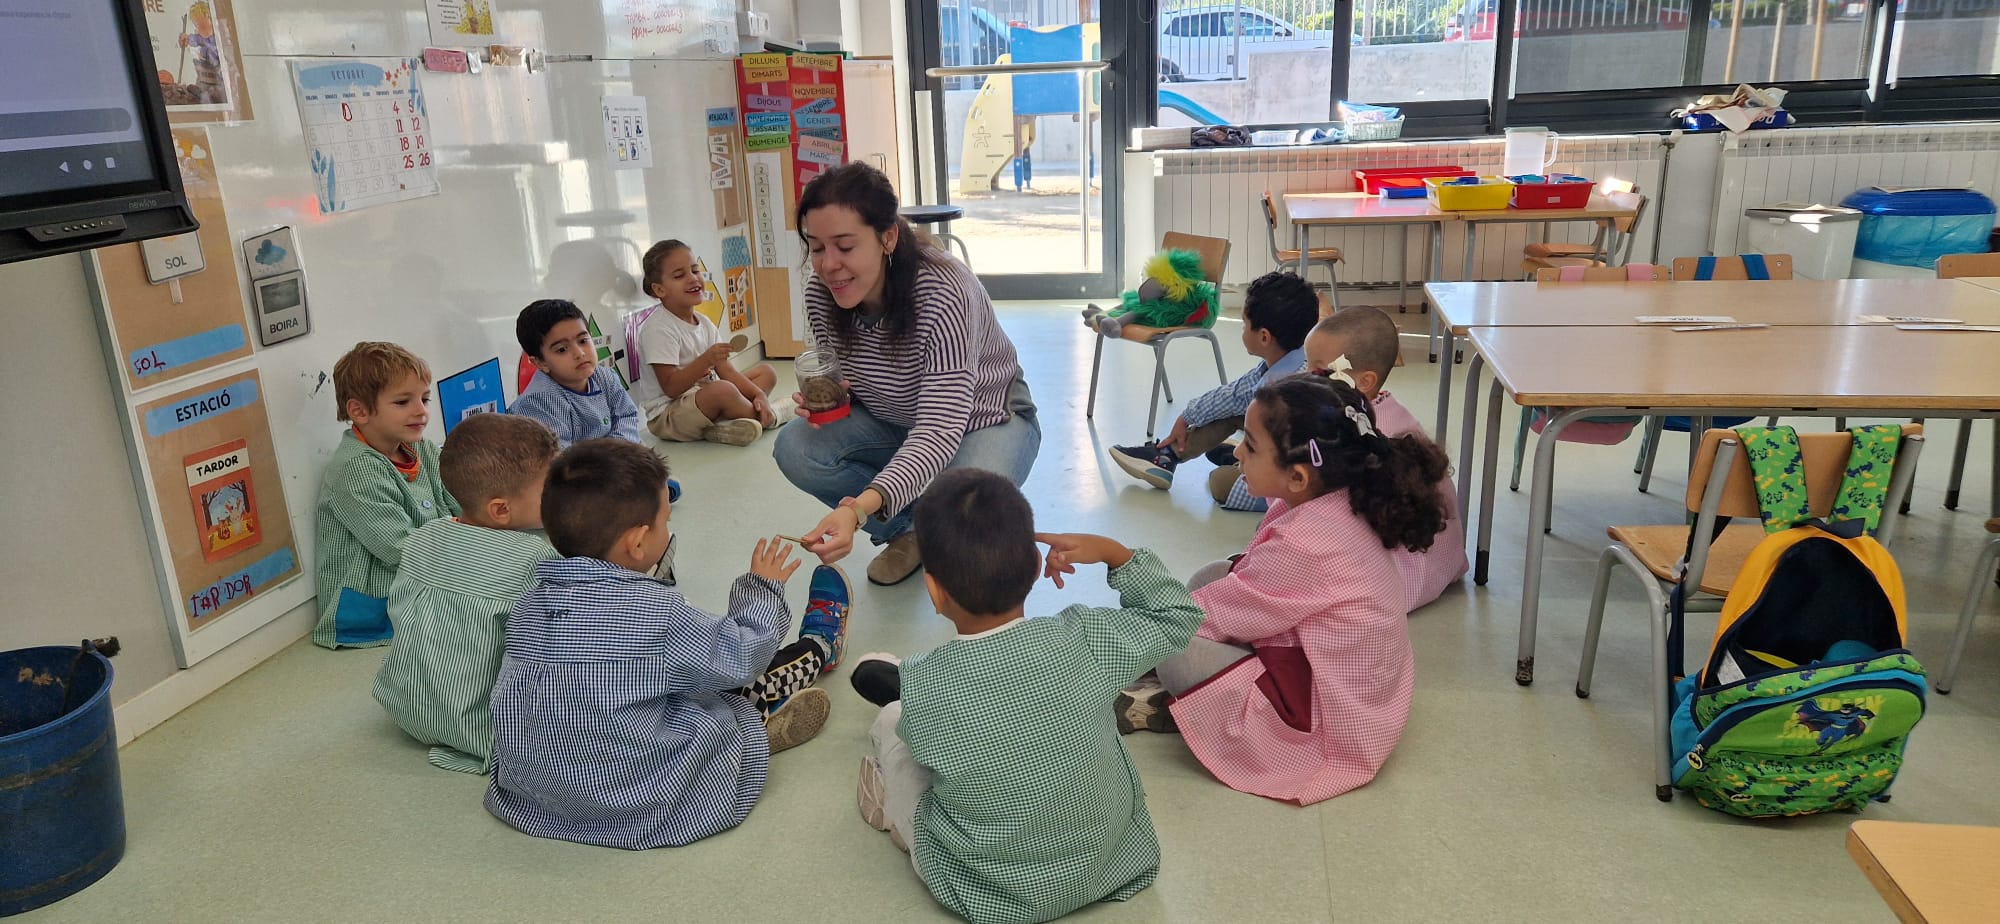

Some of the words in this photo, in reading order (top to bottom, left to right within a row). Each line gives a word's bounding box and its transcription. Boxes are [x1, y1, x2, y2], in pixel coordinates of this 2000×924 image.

[749, 57, 780, 65] DILLUNS
[796, 56, 833, 67] SETEMBRE
[751, 70, 783, 78] DIMARTS
[794, 87, 836, 96] NOVEMBRE
[393, 101, 400, 114] 4
[408, 99, 415, 113] 5
[756, 97, 782, 106] DIJOUS
[396, 119, 403, 133] 11
[411, 117, 420, 131] 12
[400, 137, 409, 151] 18
[415, 135, 424, 149] 19
[748, 137, 787, 147] DIUMENGE
[811, 140, 831, 149] ABRIL
[403, 154, 414, 168] 25
[419, 153, 430, 166] 26
[164, 255, 188, 270] SOL
[269, 317, 299, 334] BOIRA
[730, 319, 744, 332] CASA
[134, 351, 166, 375] SOL
[175, 389, 231, 422] ESTACIÓ
[196, 455, 239, 477] TARDOR
